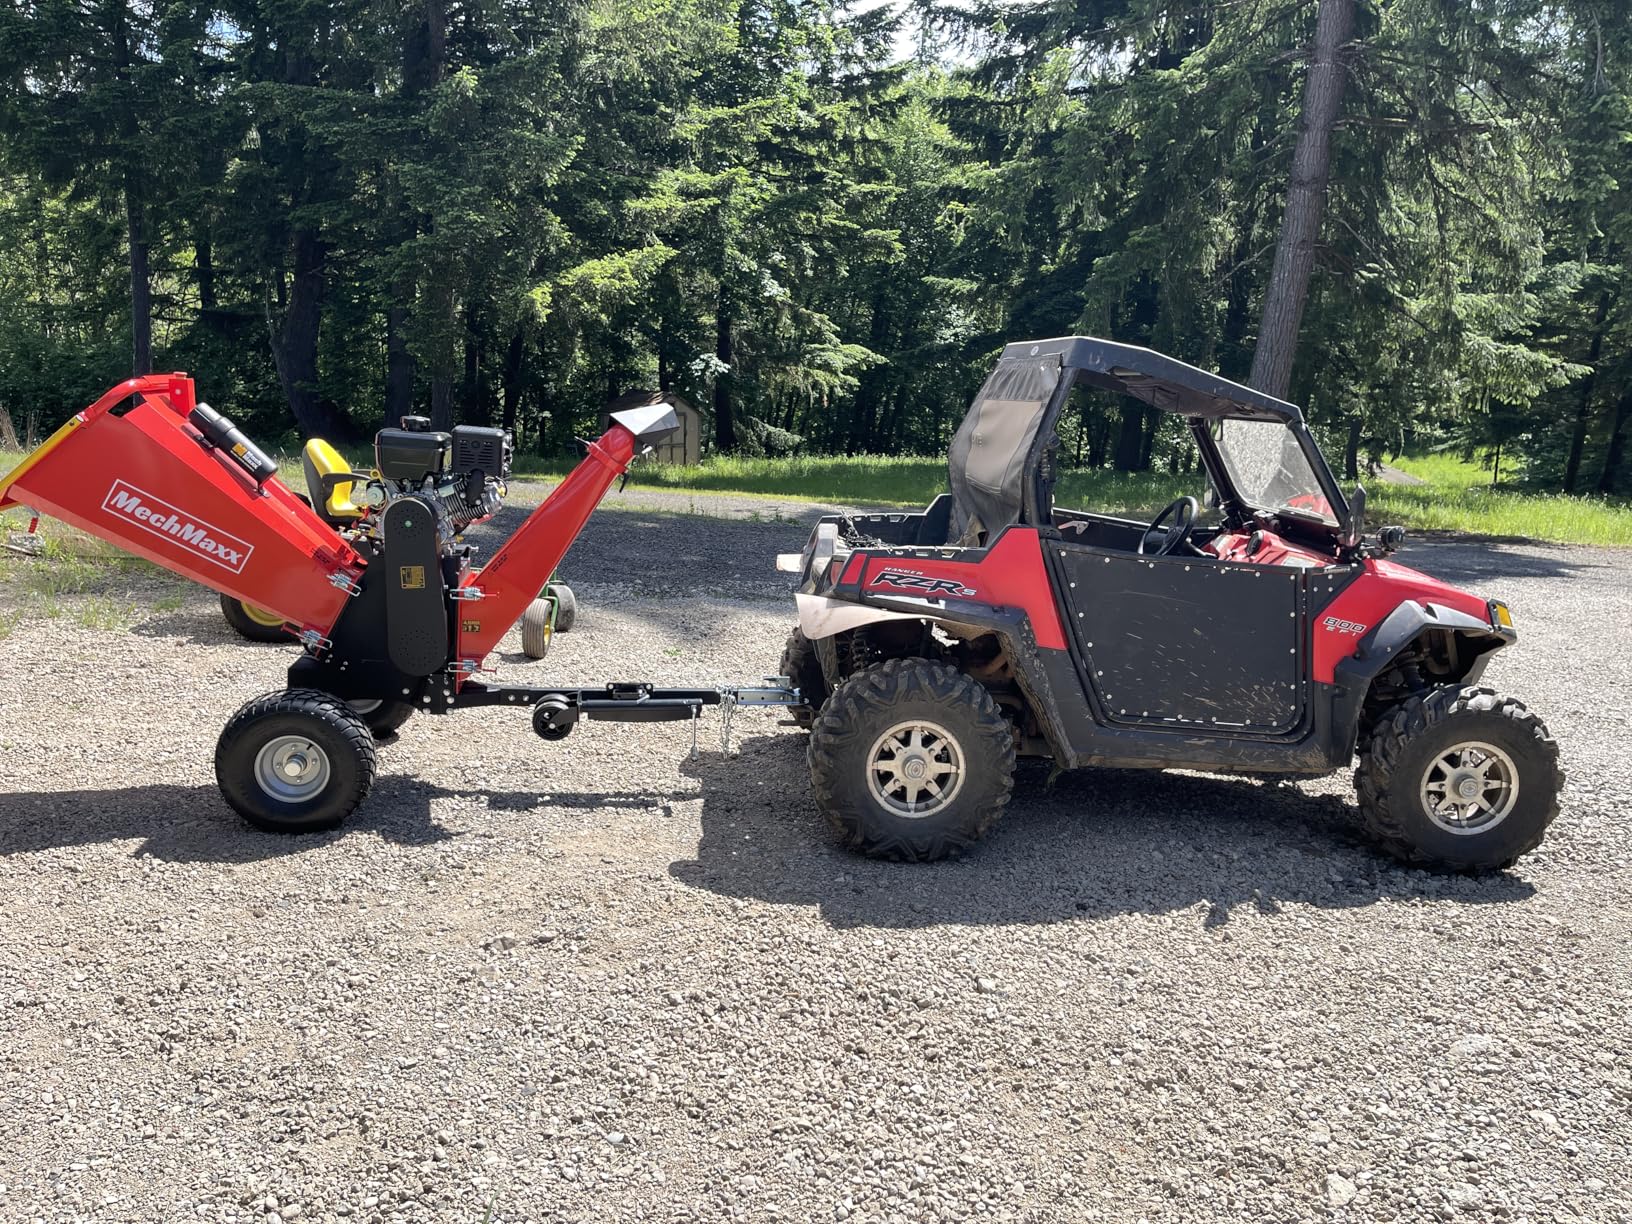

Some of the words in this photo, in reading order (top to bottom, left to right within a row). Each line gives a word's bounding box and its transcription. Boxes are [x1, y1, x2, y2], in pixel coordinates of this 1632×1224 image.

[110, 490, 243, 565] MechMaxx
[884, 566, 924, 576] RANGER
[1322, 616, 1367, 634] 800
[1326, 625, 1357, 637] EFI
